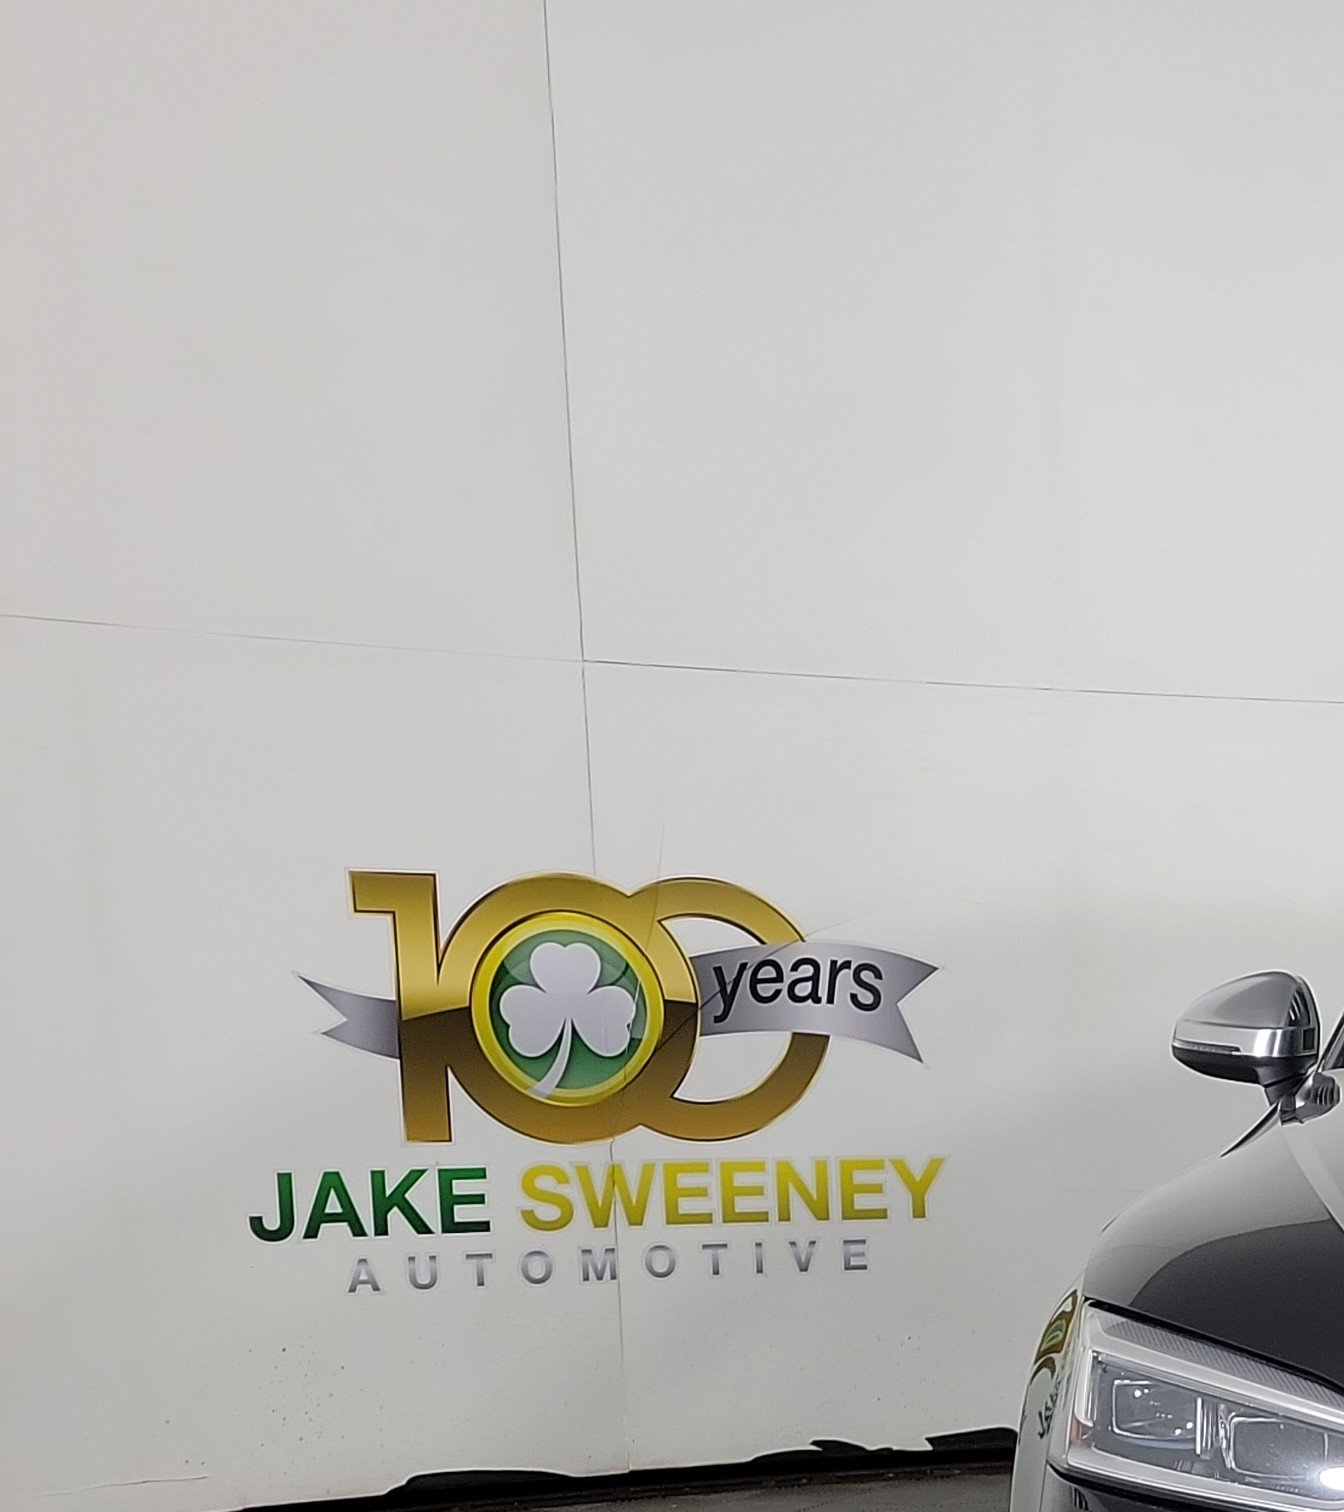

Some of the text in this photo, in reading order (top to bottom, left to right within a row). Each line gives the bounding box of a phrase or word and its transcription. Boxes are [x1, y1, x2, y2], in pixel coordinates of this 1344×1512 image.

[711, 957, 883, 1024] years
[249, 1156, 947, 1243] JAKE SWEENEY
[347, 1239, 870, 1295] AUTOMOTIVE
